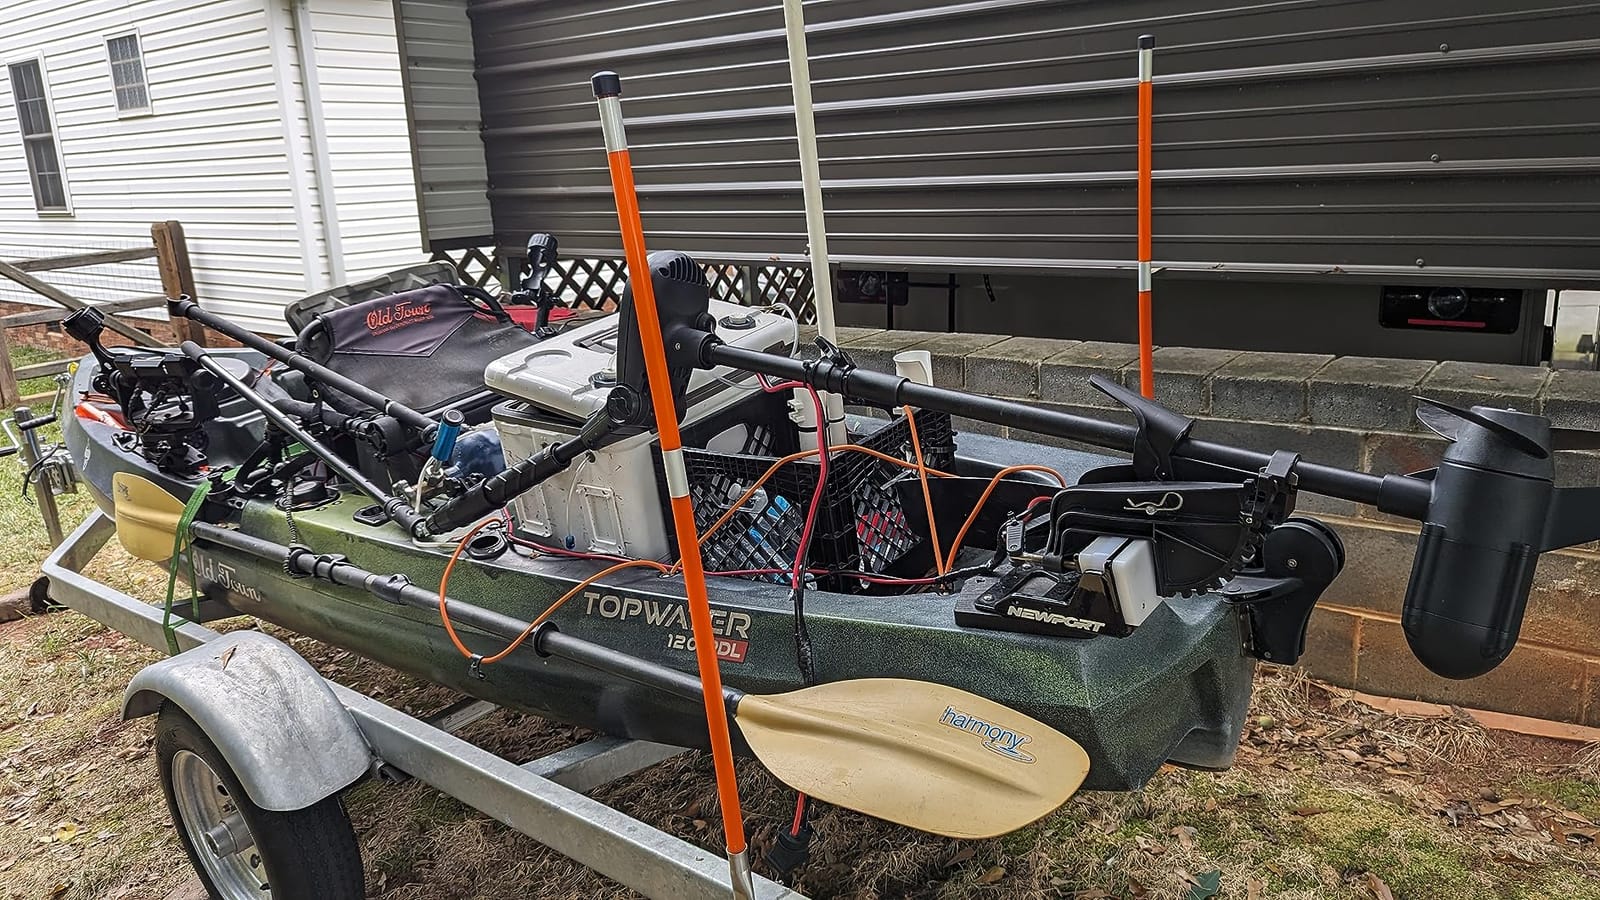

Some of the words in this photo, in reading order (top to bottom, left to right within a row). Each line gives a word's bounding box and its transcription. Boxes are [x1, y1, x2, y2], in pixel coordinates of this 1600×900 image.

[367, 306, 393, 330] Old
[394, 301, 431, 321] Town
[192, 549, 218, 584] Old
[218, 562, 261, 602] Town
[583, 591, 752, 639] TOPWAER
[1007, 605, 1106, 633] NEWPORT
[940, 705, 1025, 750] harmony
